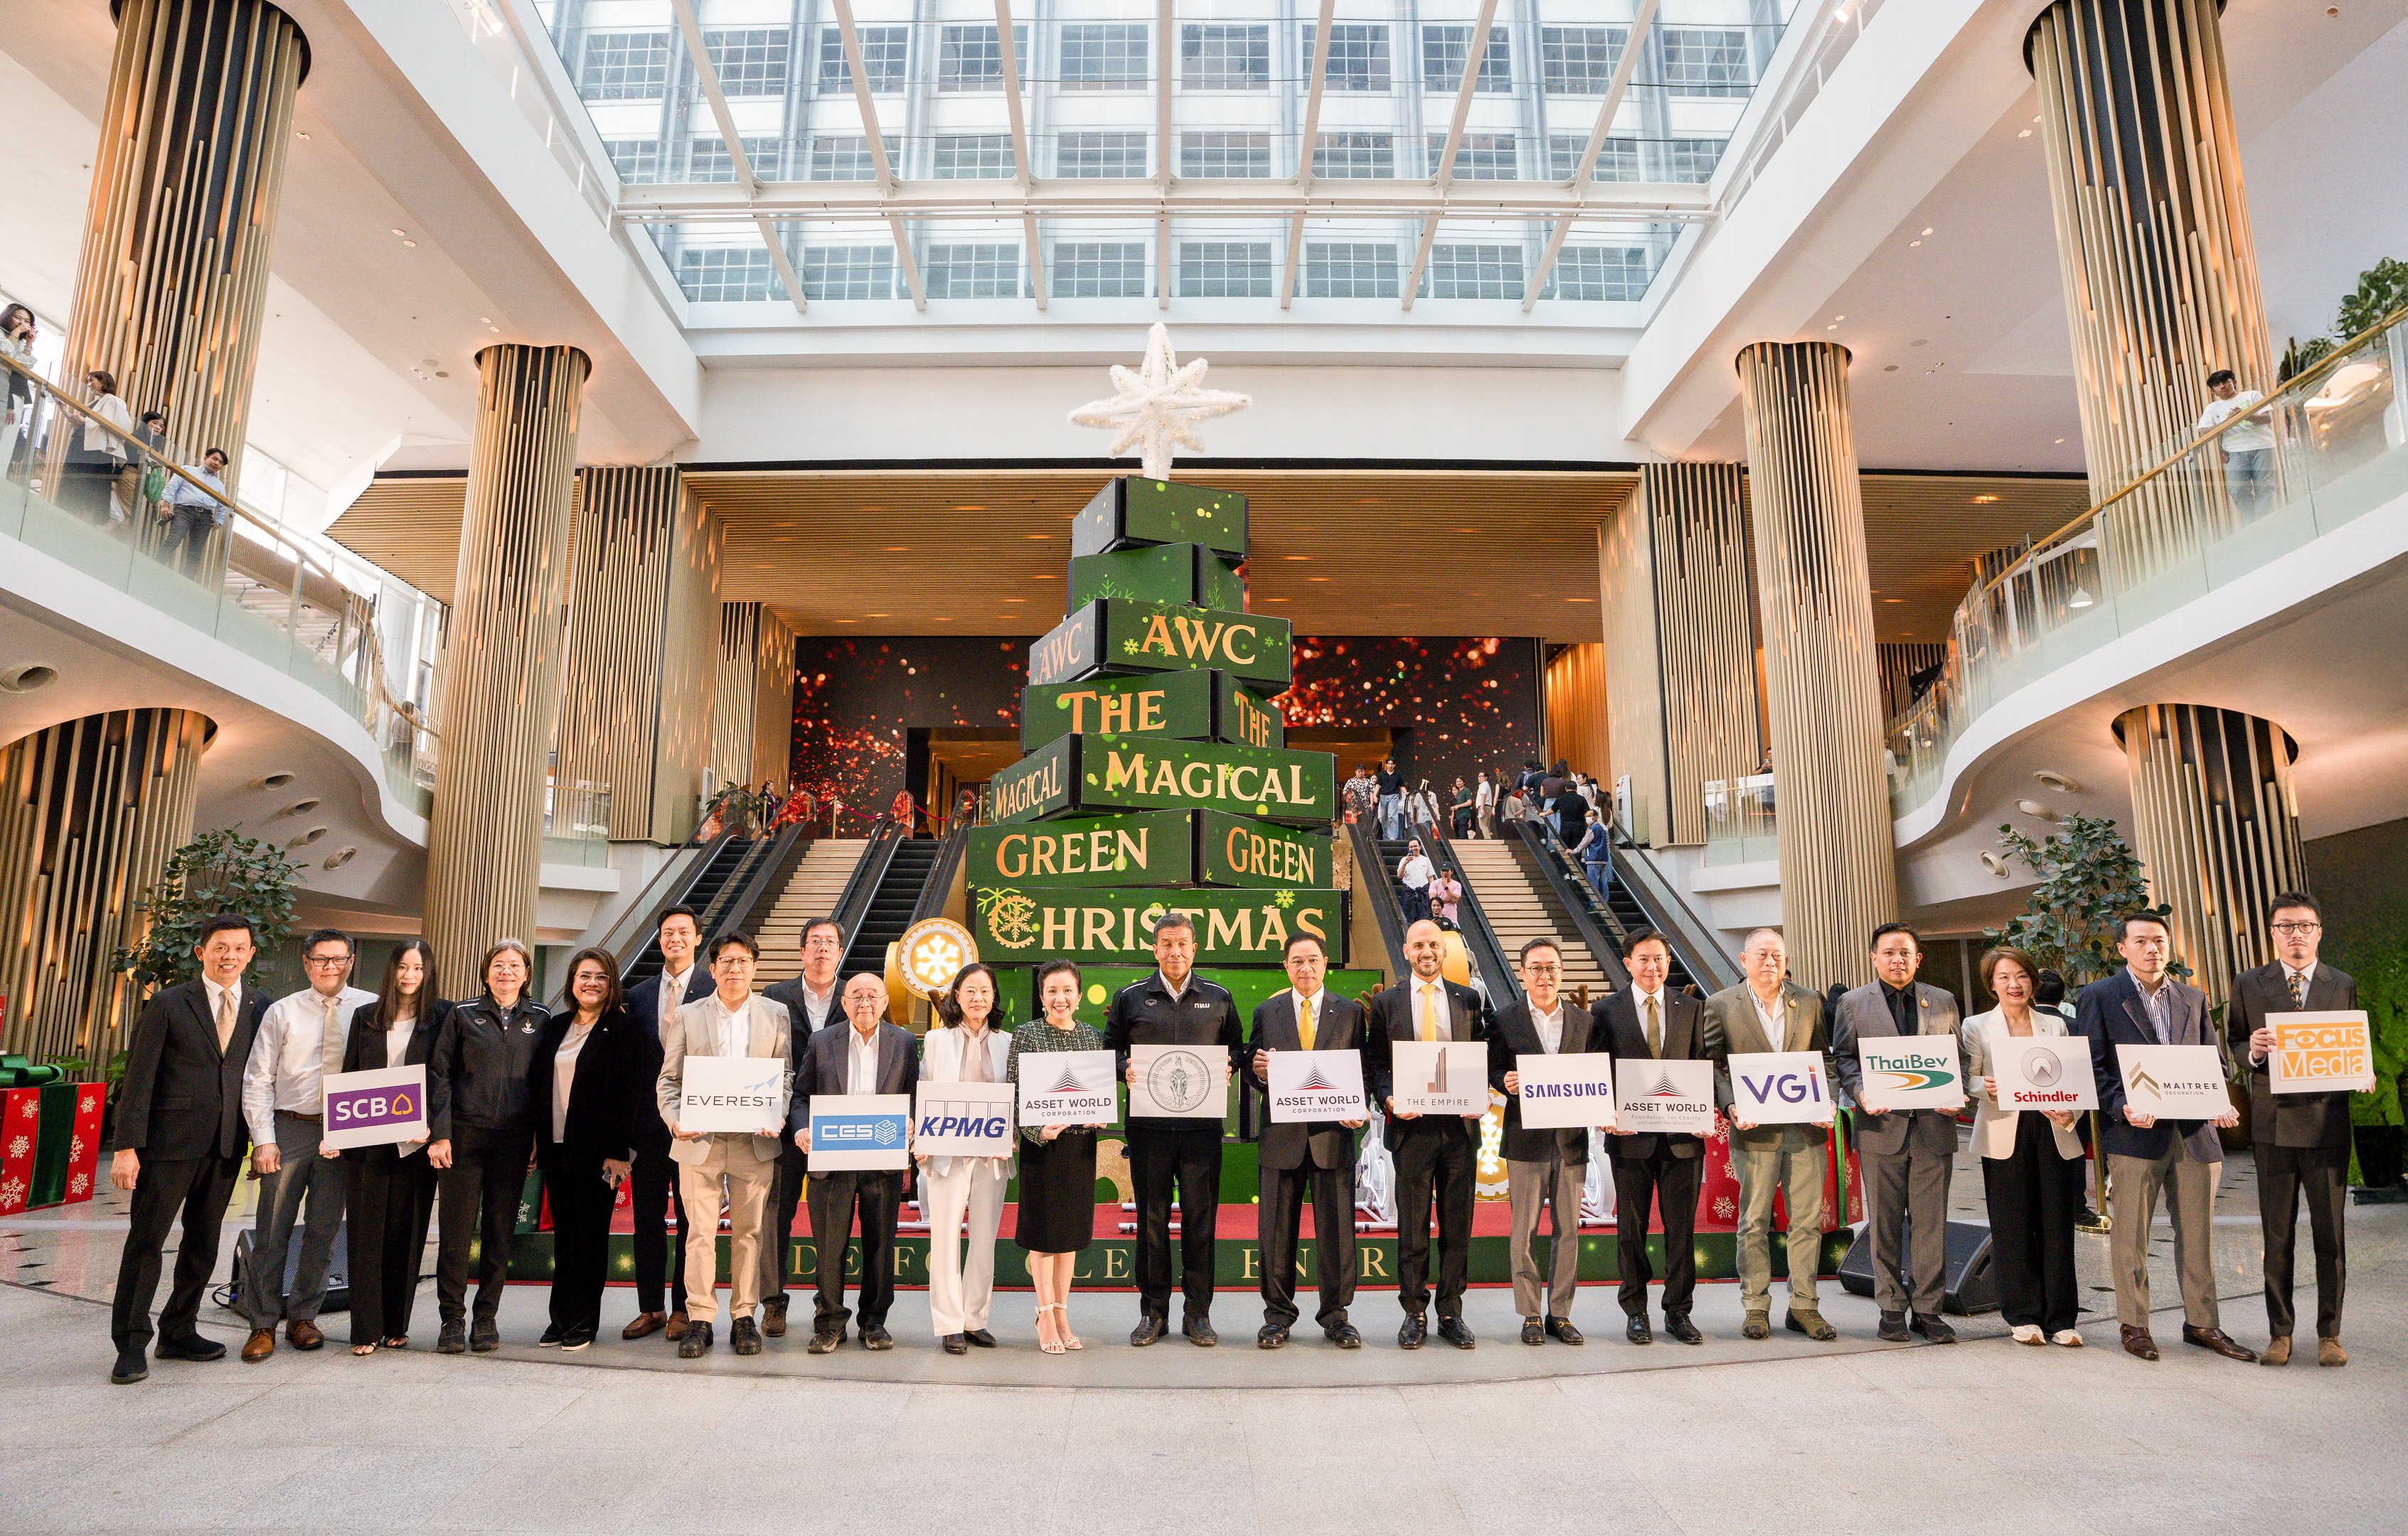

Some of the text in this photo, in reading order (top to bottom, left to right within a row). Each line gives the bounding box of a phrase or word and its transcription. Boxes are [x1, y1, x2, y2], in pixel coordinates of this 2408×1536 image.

[1037, 622, 1082, 685] AWC
[1140, 615, 1256, 666] AWC
[1060, 689, 1166, 734] THE
[1234, 691, 1270, 747] THE
[994, 756, 1062, 823] MAGICAL
[1104, 751, 1316, 805] MAGICAL
[996, 828, 1149, 878] GREEN
[1226, 826, 1314, 885] GREEN
[1865, 1054, 1949, 1071] ThaiBev
[2279, 1048, 2367, 1080] Media
[687, 1095, 777, 1107] EVEREST
[1025, 1097, 1112, 1109] ASSET WORLD
[1276, 1095, 1360, 1106] ASSET WORLD
[1525, 1082, 1608, 1099] SAMSUNG
[2013, 1091, 2079, 1103] Schindler
[336, 1096, 388, 1122] SCB
[1624, 1102, 1708, 1112] ASSET WORLD
[821, 1124, 873, 1138] CES
[919, 1116, 1006, 1138] KPMG
